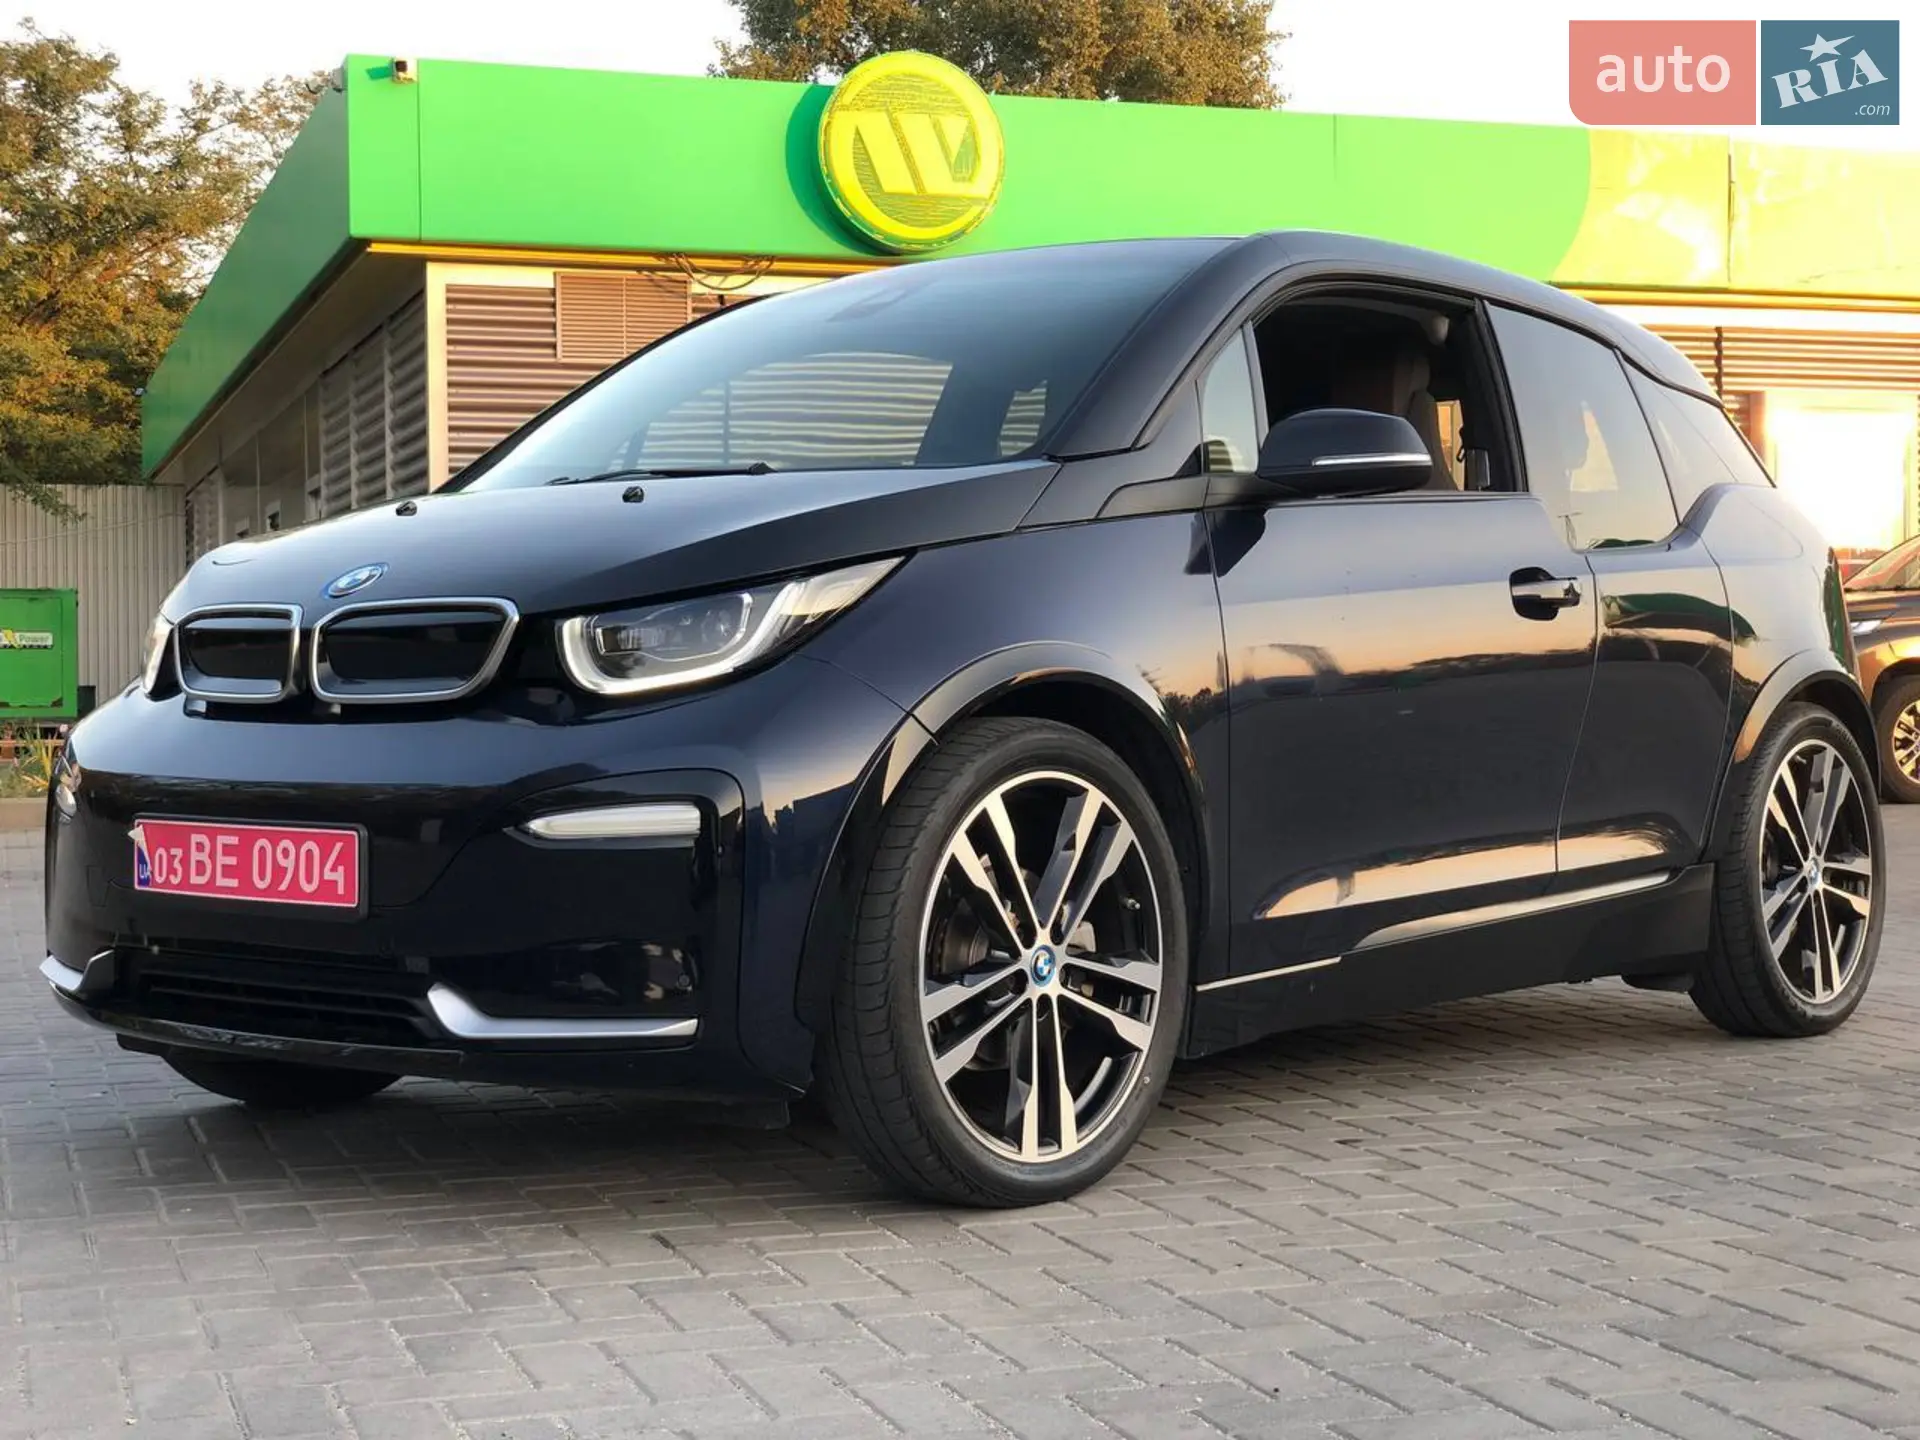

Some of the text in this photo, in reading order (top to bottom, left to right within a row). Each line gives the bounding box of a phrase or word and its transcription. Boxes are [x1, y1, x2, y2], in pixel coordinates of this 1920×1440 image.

[154, 833, 346, 895] 03 BE 0904
